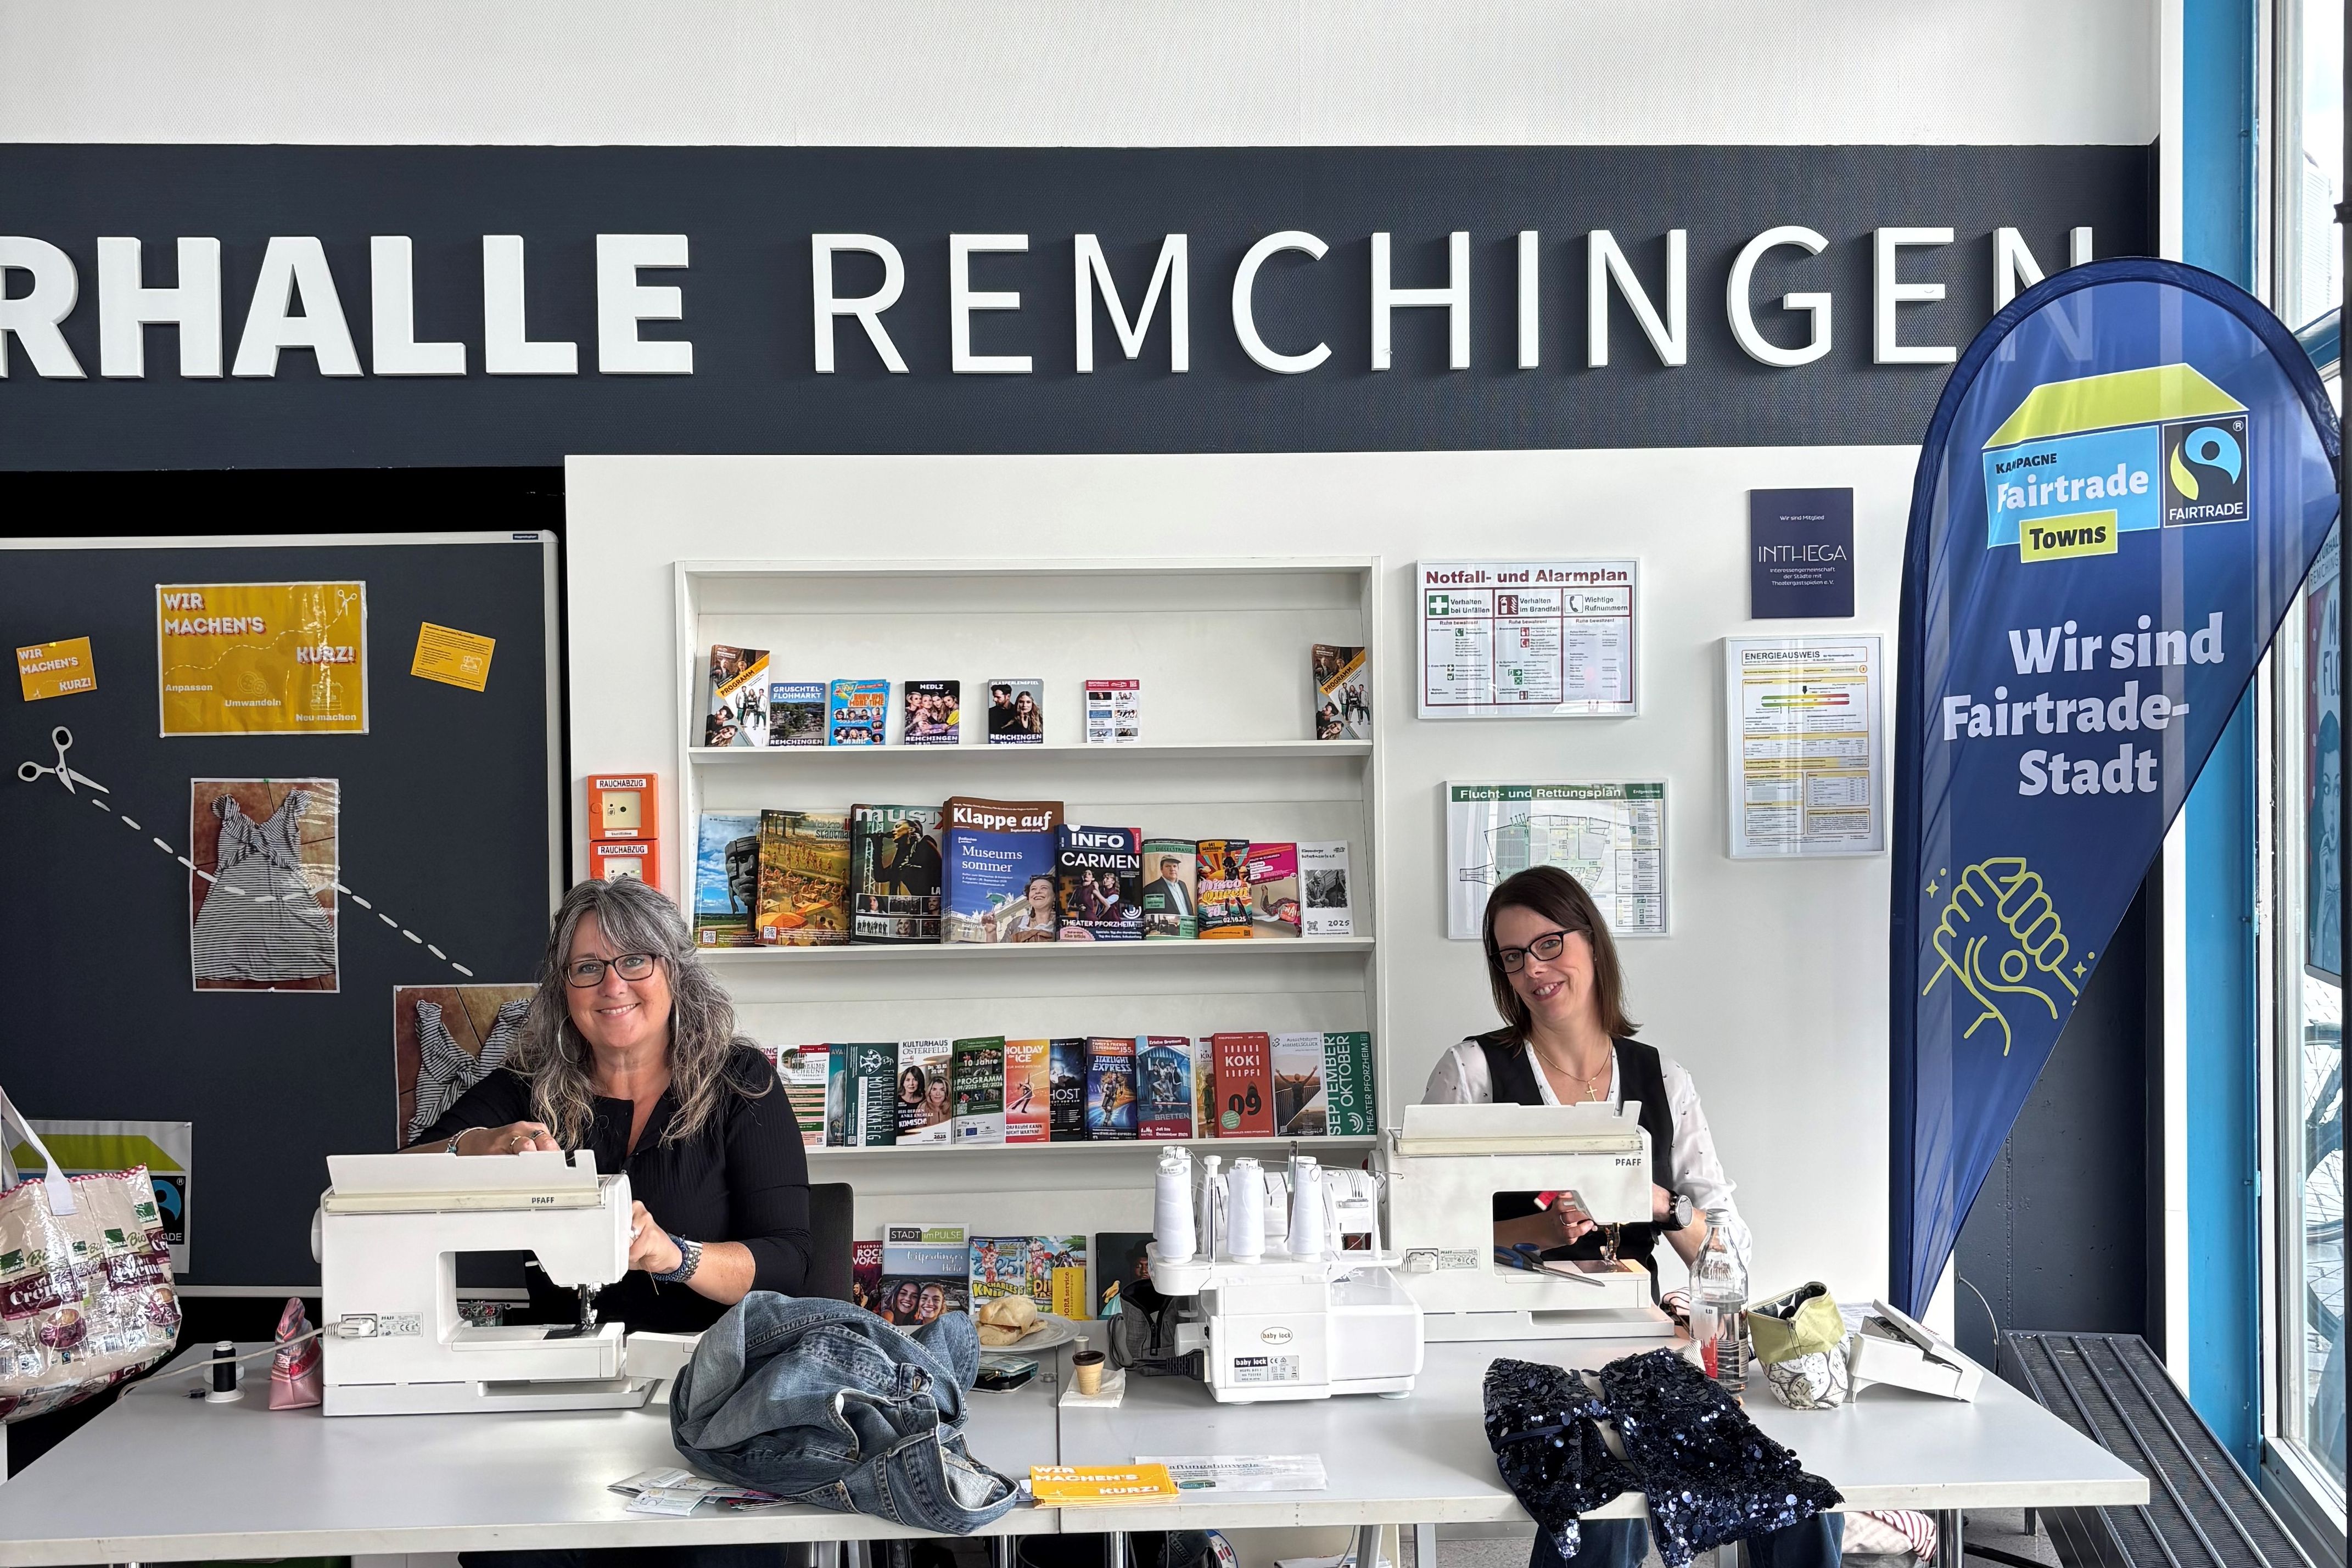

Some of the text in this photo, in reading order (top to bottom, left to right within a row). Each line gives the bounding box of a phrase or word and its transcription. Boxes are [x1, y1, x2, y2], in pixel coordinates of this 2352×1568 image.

[813, 225, 2093, 375] REMCHINGEN
[1997, 462, 2149, 513] Fairtrade
[2170, 502, 2243, 520] FAIRTRADE
[2029, 525, 2107, 551] Towns
[1759, 545, 1847, 563] INTHEGA
[1426, 568, 1627, 584] Notfall- und Alarmplan
[163, 592, 205, 611] WIR
[1584, 596, 1614, 604] Wichtige
[165, 617, 267, 636] MACHEN'S
[2008, 612, 2225, 675] Wir sind
[19, 648, 43, 660] WIR
[296, 646, 357, 665] KURZ!
[1745, 651, 1820, 660] ENERGIEAUSWEIS
[21, 657, 79, 675] MACHEN'S
[59, 677, 91, 691] KURZ!
[720, 670, 755, 696] PROGRAMM
[1324, 667, 1353, 692] PROGRAMM
[166, 684, 213, 693] Anpassen
[225, 698, 281, 707] Umwandeln
[1943, 680, 2190, 741] Fairtrade-
[2019, 743, 2158, 796] Stadt
[1460, 788, 1621, 799] Flucht- und Rettungsplan
[954, 808, 1052, 831] Klappe auf
[1072, 833, 1124, 848] INFO
[601, 845, 645, 854] RAUCHABZUG
[962, 845, 1023, 859] Museums
[962, 860, 1012, 872] sommer
[1061, 852, 1140, 869] CARMEN
[903, 1046, 948, 1055] OSTERFELD
[1006, 1045, 1044, 1054] HOLIDAY
[1016, 1054, 1032, 1062] ICE
[1225, 1055, 1259, 1067] KOKI
[1337, 1036, 1354, 1107] OKTOBER
[957, 1075, 1003, 1085] PROGRAMM
[1324, 1037, 1341, 1135] SEPTEMBER
[1050, 1088, 1080, 1100] HOST
[1361, 1043, 1374, 1133] THEATER PFORZHEIM
[882, 1069, 894, 1132] FIGURENTHEATER
[891, 1231, 961, 1239] STADT imPULSE
[853, 1257, 882, 1267] VOICE
[973, 1283, 1005, 1297] KNIE
[988, 1282, 1018, 1295] CHARLES
[1099, 1486, 1159, 1494] KURZ!
